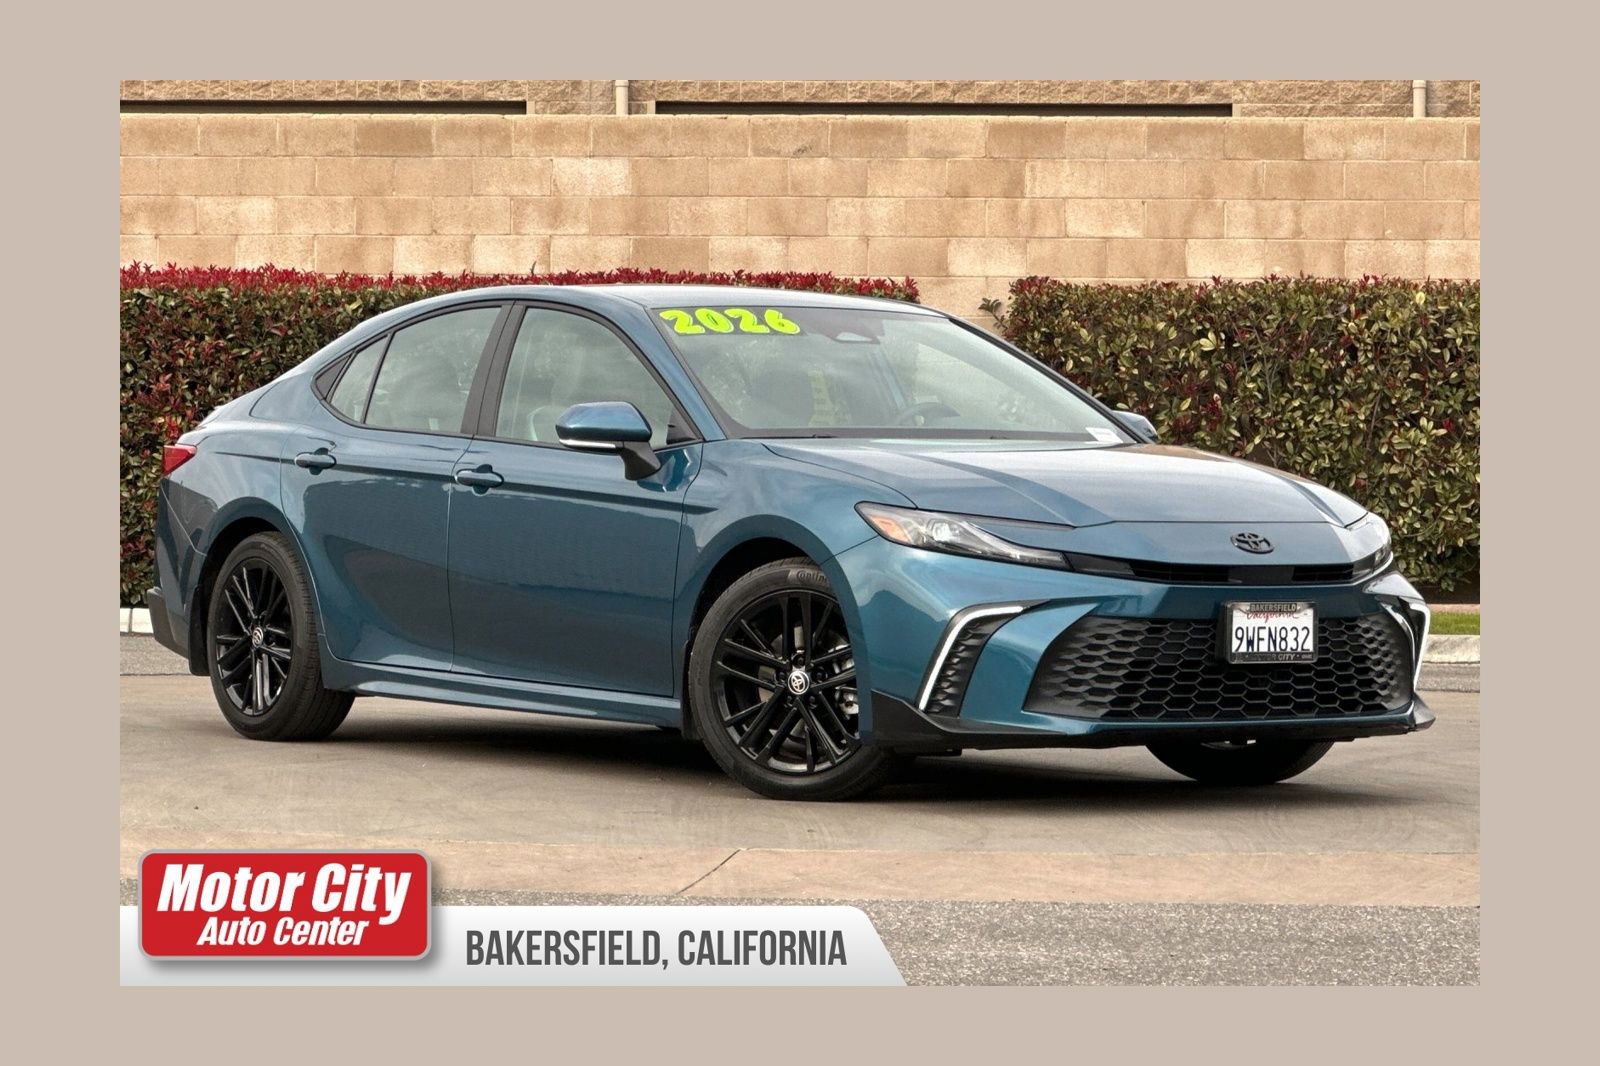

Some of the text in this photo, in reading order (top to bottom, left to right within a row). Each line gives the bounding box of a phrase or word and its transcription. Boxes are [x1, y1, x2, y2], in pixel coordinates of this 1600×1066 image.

[659, 308, 801, 334] 2026
[1250, 604, 1297, 612] BAKERSFIELD
[1235, 626, 1310, 652] 9WFN832
